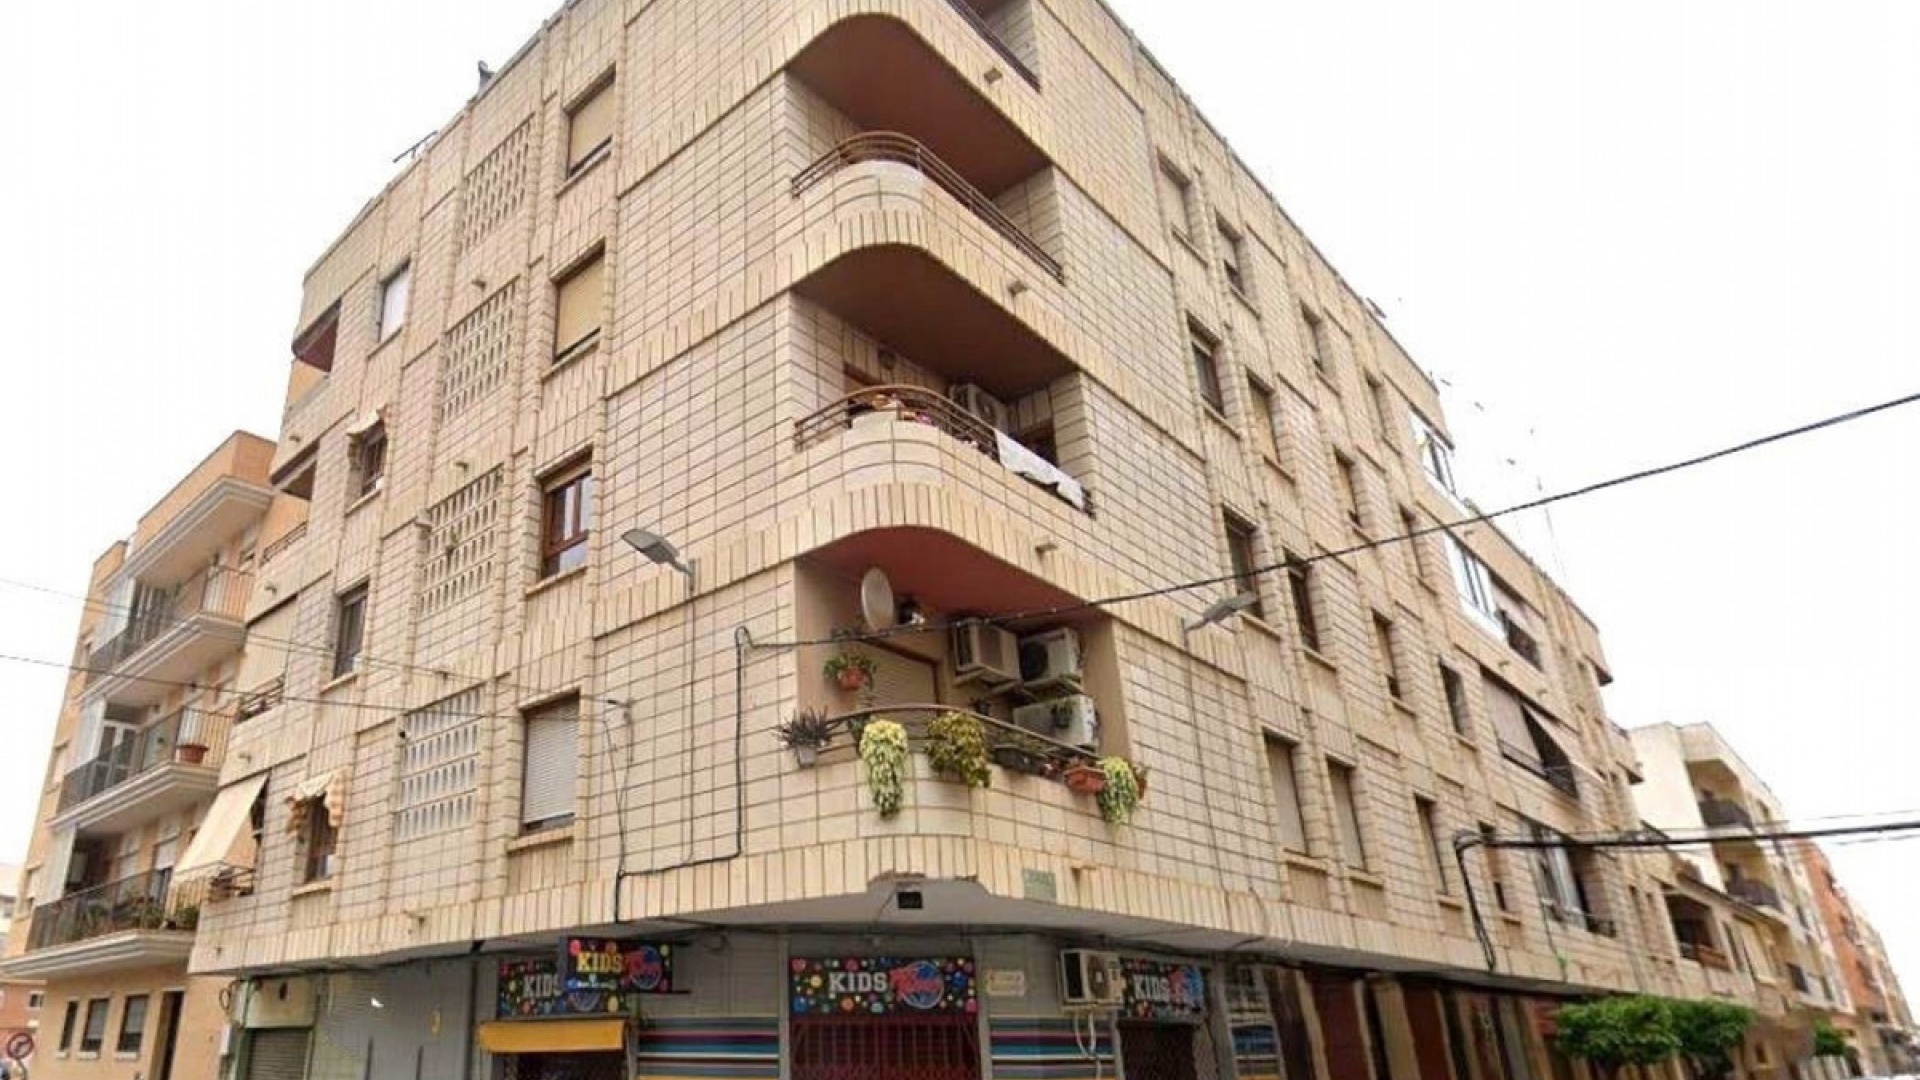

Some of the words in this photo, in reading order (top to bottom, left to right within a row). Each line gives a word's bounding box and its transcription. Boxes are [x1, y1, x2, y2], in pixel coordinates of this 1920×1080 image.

[577, 952, 623, 973] KIDS
[829, 972, 888, 992] KIDS
[1133, 975, 1170, 1000] KIDS
